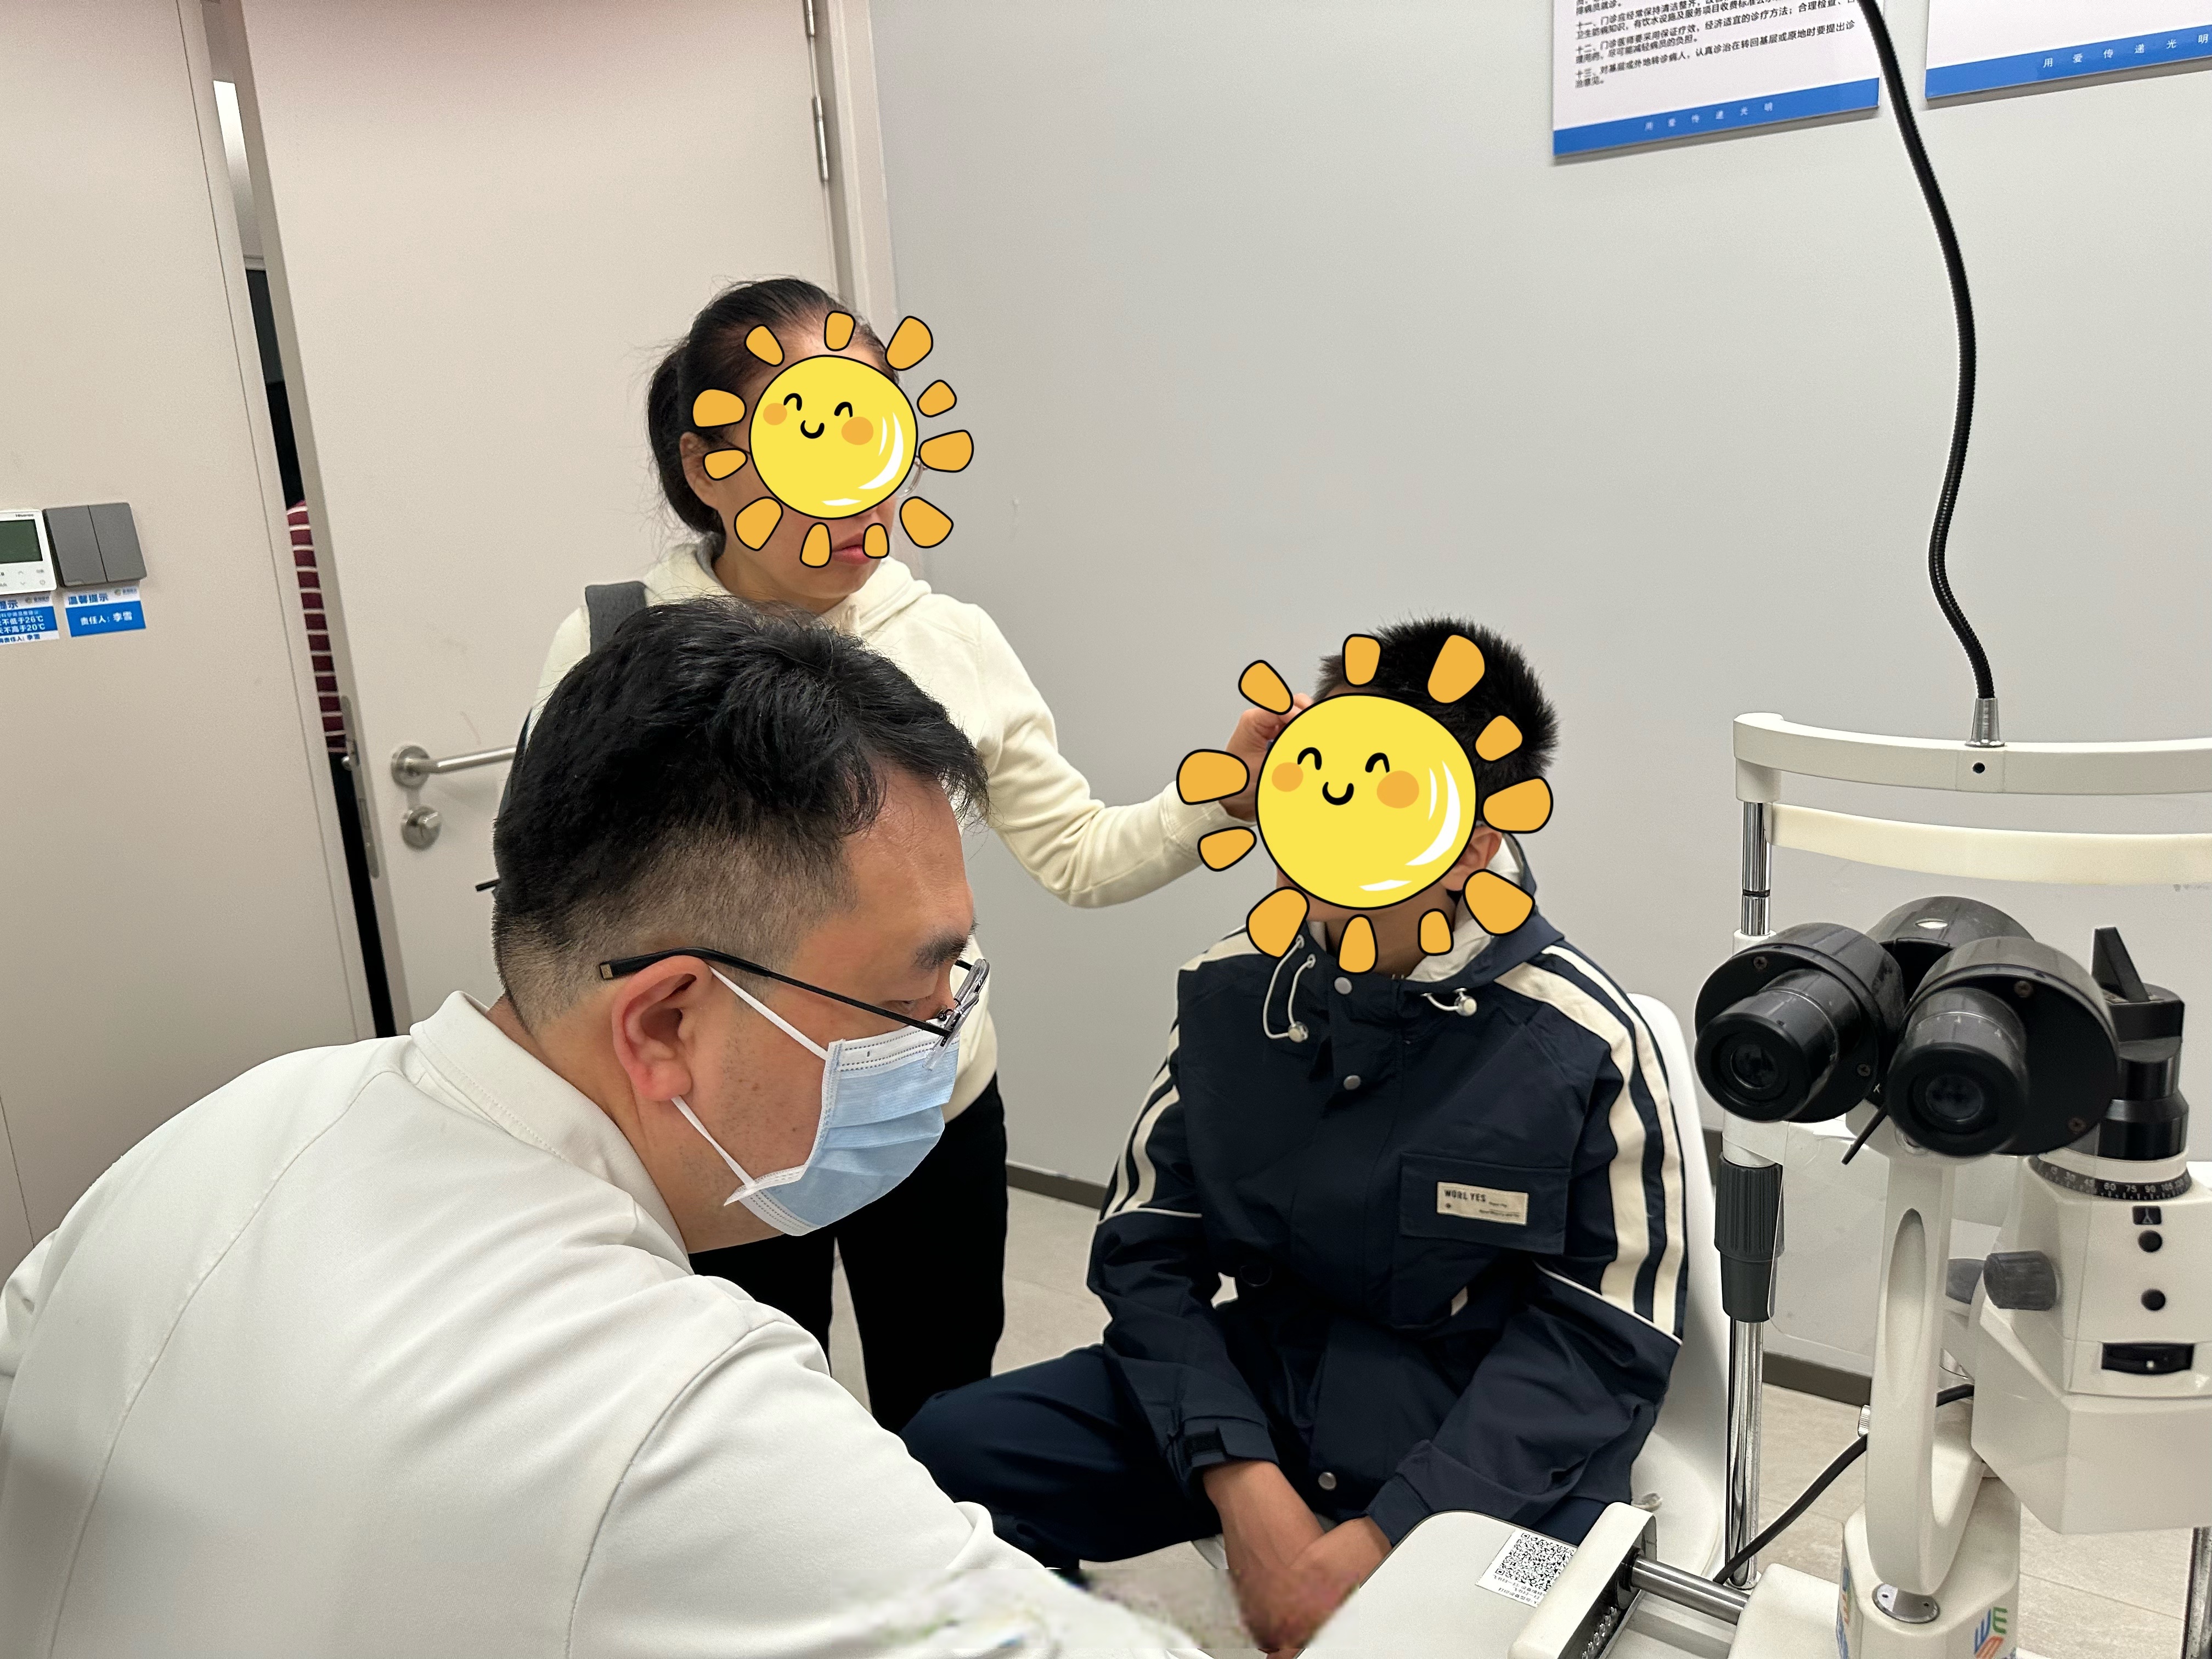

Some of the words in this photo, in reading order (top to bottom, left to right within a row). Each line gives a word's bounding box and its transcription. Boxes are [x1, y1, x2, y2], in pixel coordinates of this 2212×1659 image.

[2042, 33, 2209, 69] 用爱传递光明
[2103, 1183, 2116, 1192] 60
[2125, 1184, 2137, 1193] 75
[2145, 1185, 2156, 1193] 90
[1470, 1192, 1486, 1202] YES
